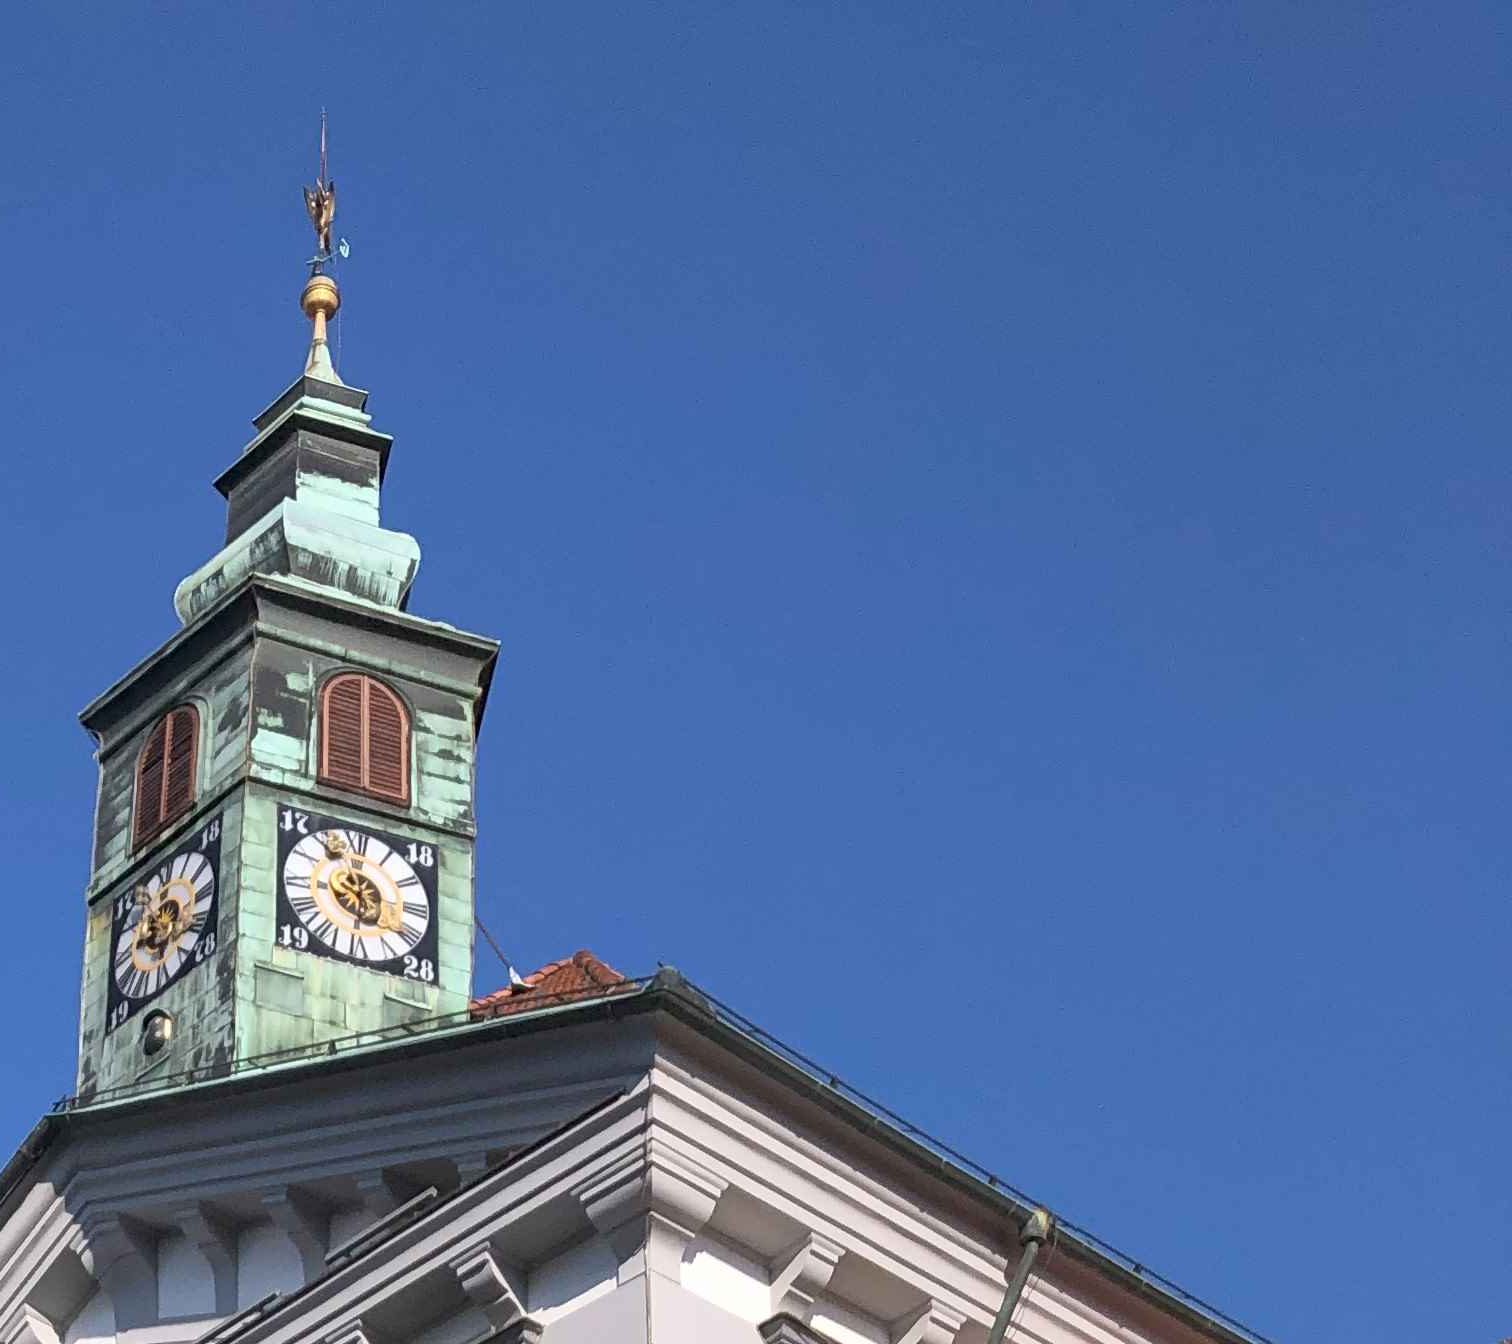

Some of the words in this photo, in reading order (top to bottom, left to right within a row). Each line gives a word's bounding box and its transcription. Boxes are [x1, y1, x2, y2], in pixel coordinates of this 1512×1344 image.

[279, 809, 309, 834] 17
[201, 819, 219, 850] 18
[404, 843, 434, 867] 18
[278, 924, 309, 949] 19
[403, 955, 435, 981] 28
[111, 1000, 129, 1032] 19
